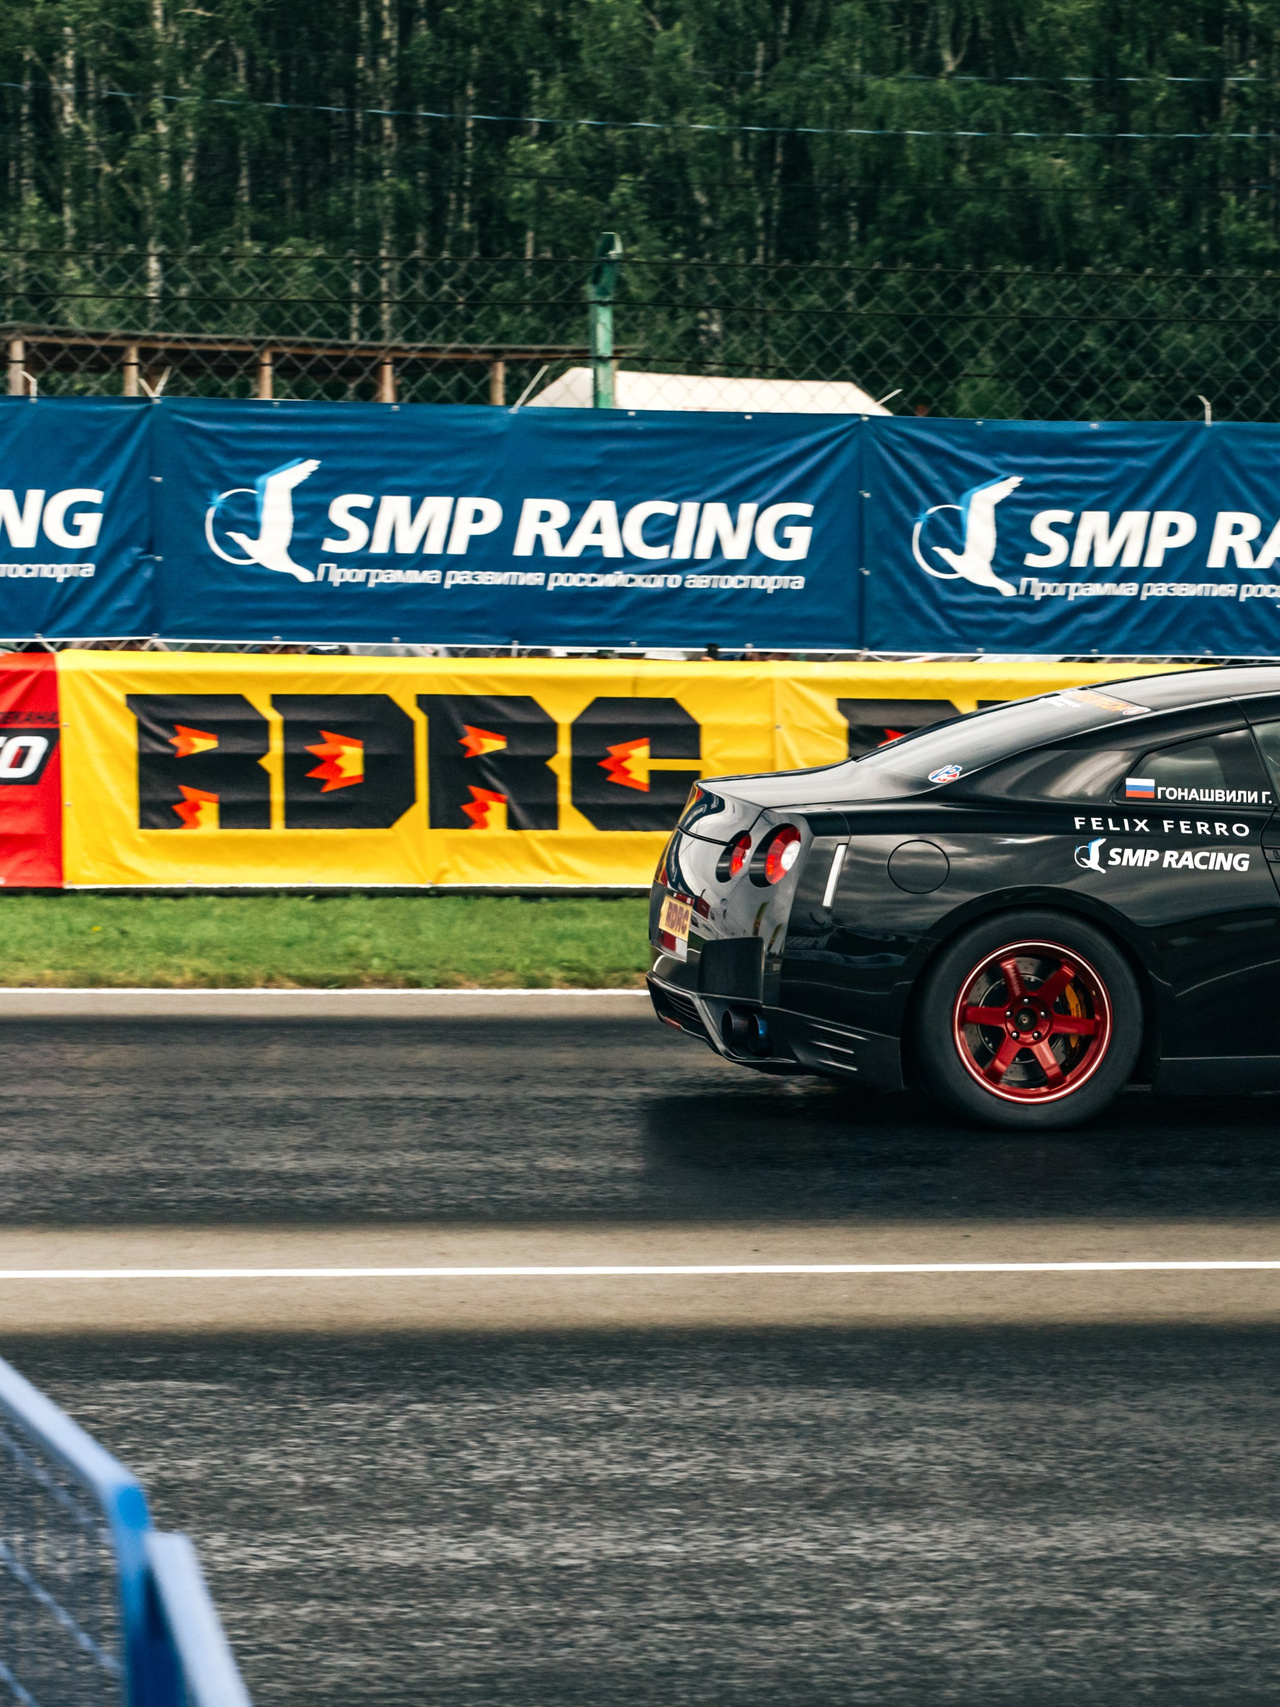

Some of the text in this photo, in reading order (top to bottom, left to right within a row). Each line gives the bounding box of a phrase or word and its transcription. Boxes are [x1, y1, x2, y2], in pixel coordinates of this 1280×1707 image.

[321, 493, 815, 561] SMP RACING
[1023, 509, 1197, 568] SMP
[316, 563, 805, 593] Программа развития российского автоспорта
[1019, 578, 1139, 600] Программа
[1141, 583, 1238, 600] развития
[126, 694, 703, 832] RDRC
[1157, 786, 1273, 804] ГОНАШВИЛИ Г.
[1073, 816, 1250, 837] FELIX FERRO
[1107, 847, 1251, 872] SMP RACING
